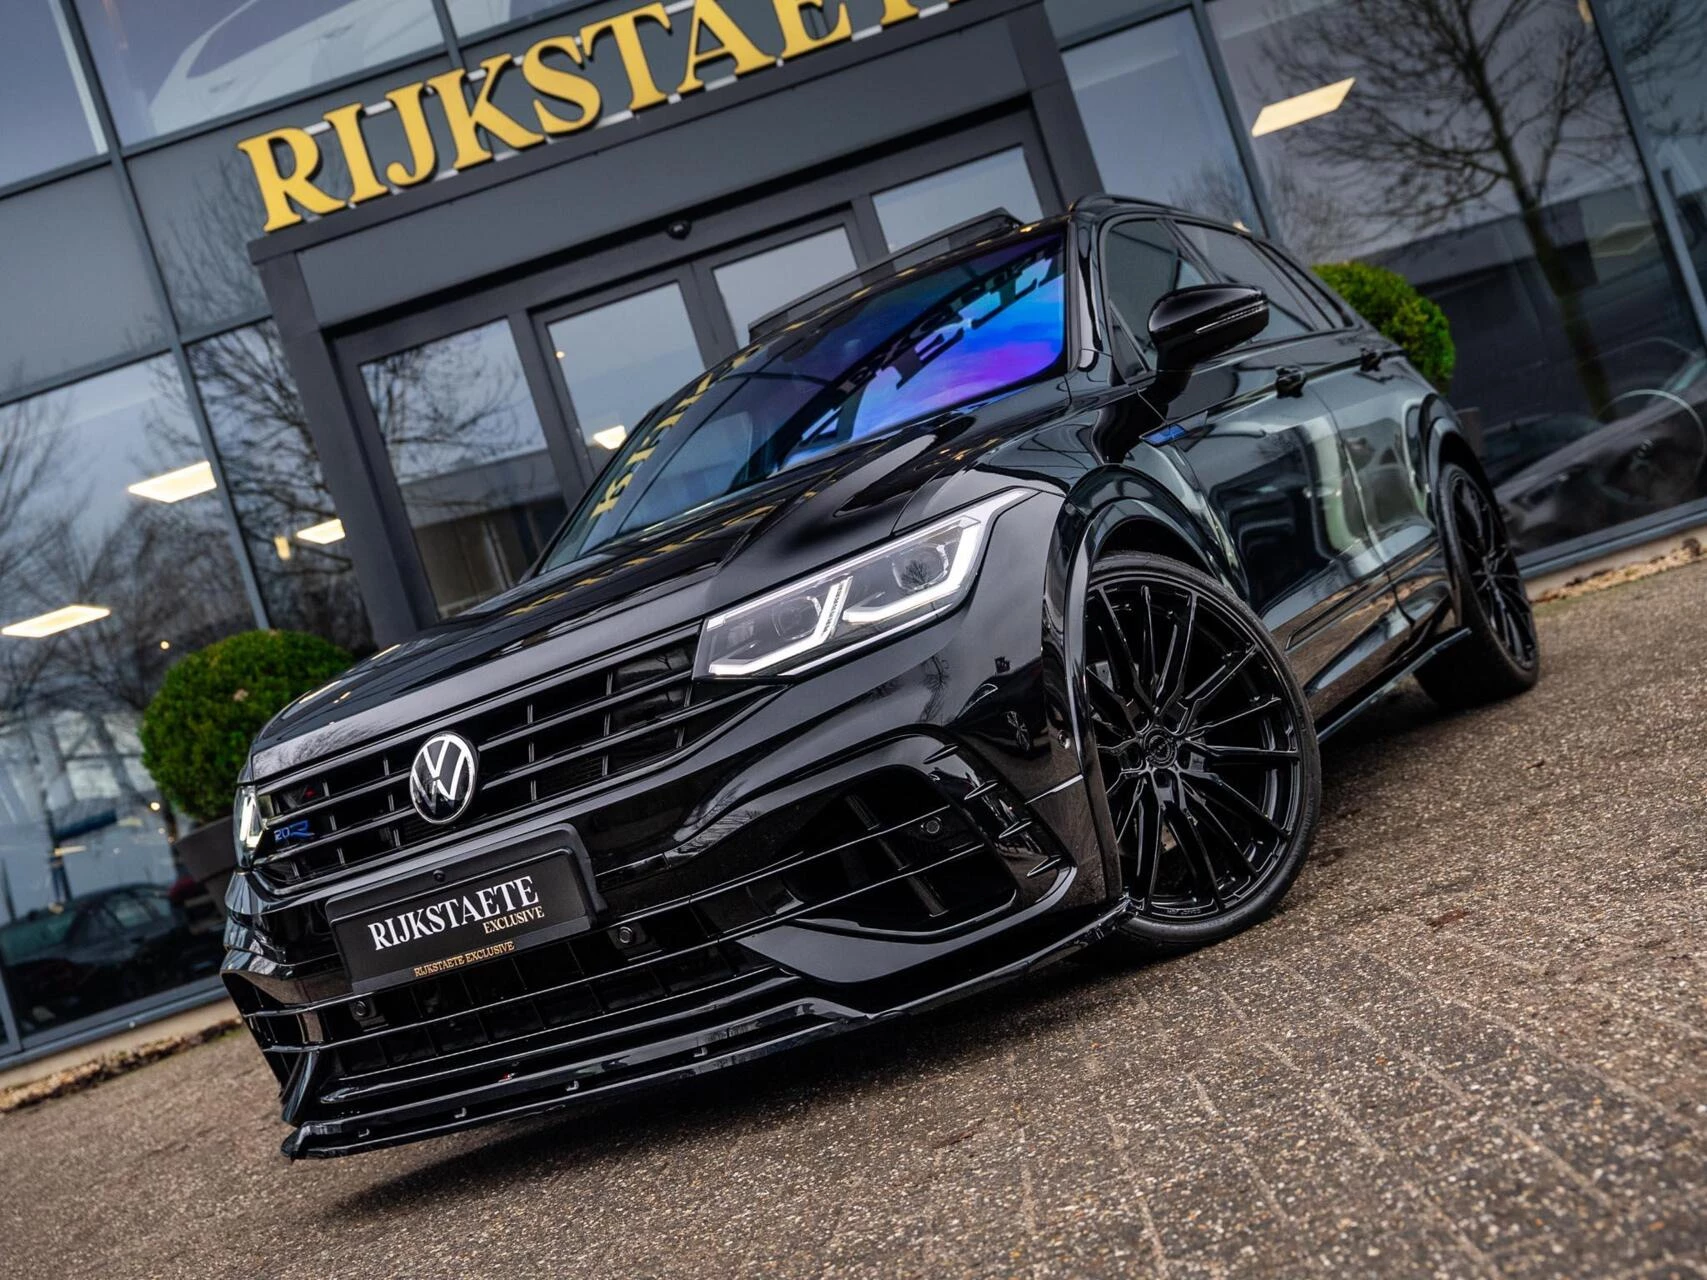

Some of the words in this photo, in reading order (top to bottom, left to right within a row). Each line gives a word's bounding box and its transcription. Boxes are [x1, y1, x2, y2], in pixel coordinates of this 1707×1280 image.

[237, 0, 955, 232] RIJKSTAE
[367, 875, 540, 951] RIJKSTAETE
[482, 905, 545, 934] EXCLUSIVE
[414, 955, 465, 977] RIJKSTAETE
[465, 940, 515, 962] EXCLUSIVE
